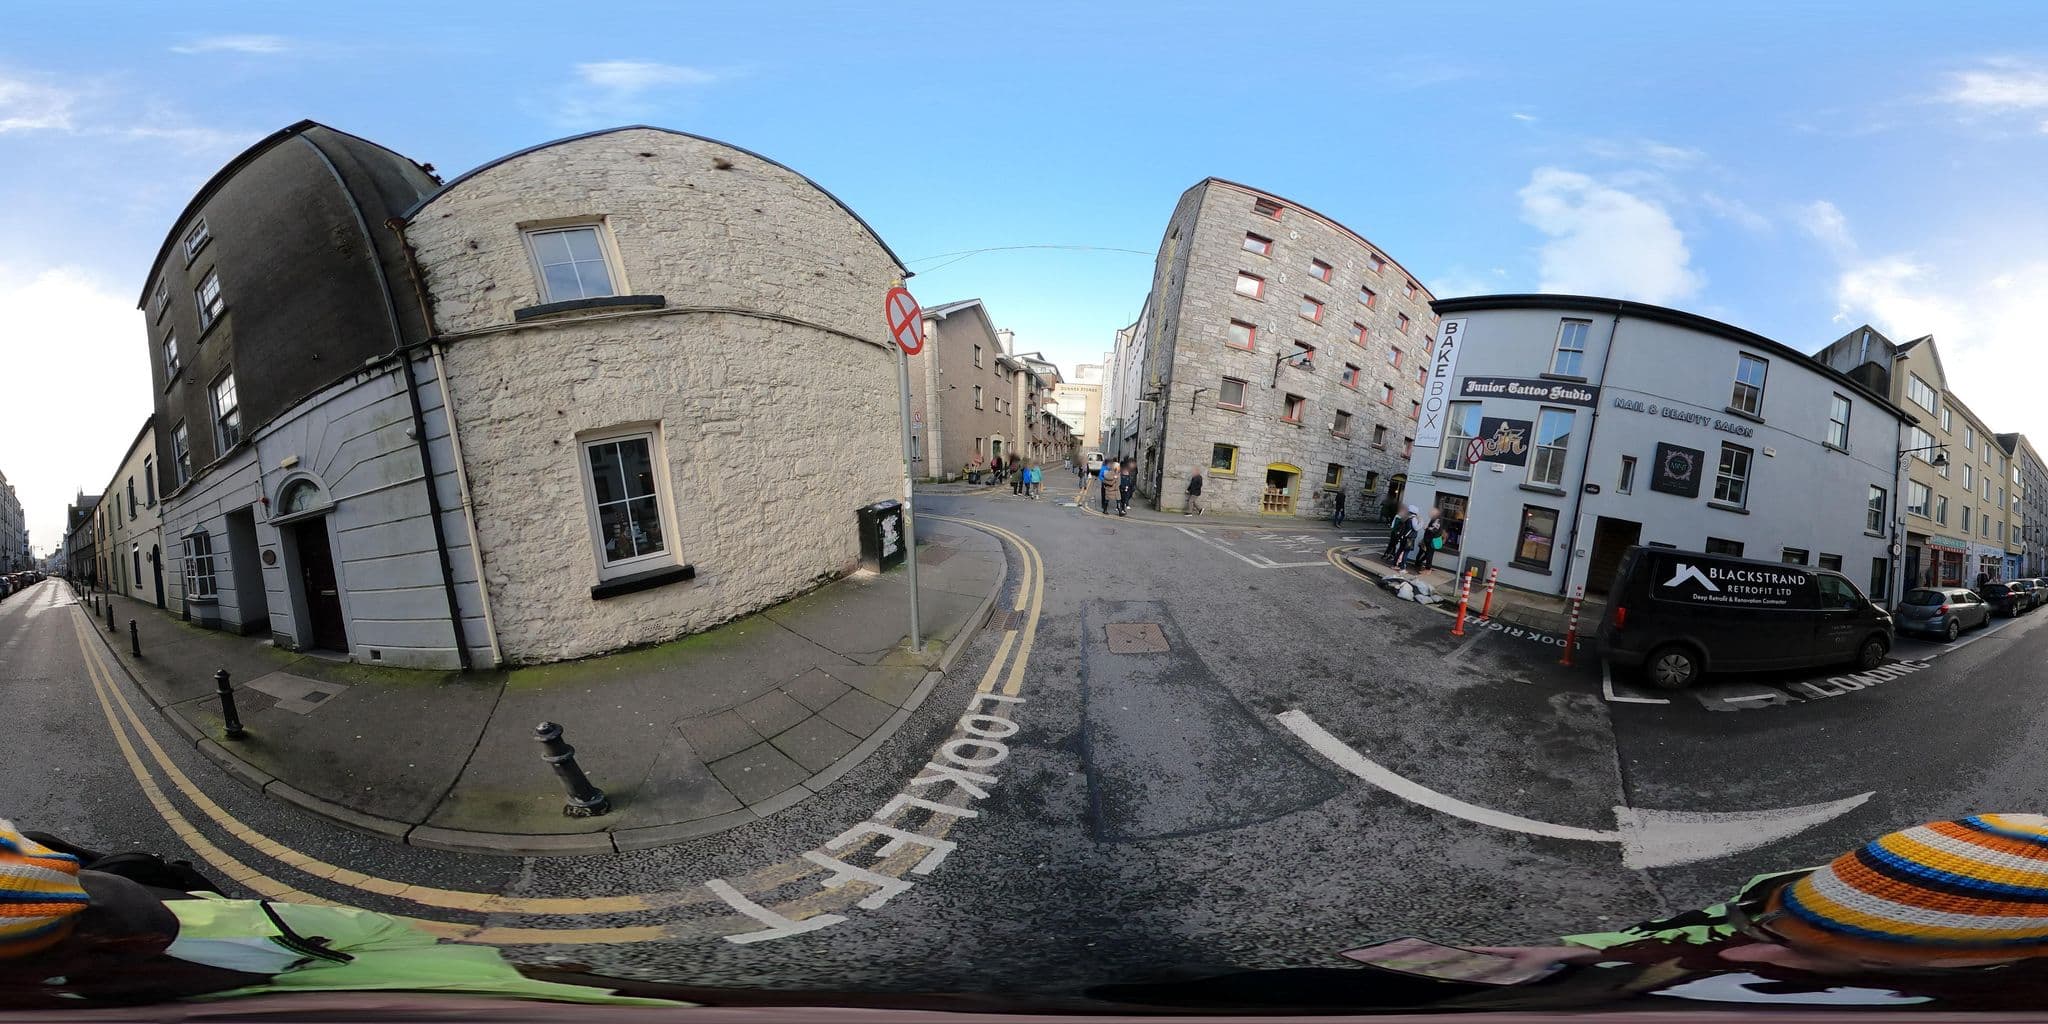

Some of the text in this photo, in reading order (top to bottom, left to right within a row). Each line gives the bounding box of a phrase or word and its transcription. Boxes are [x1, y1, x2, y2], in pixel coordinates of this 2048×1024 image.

[1424, 322, 1458, 430] BAKE BOX
[1466, 381, 1592, 401] Junior Tattoo Studio
[1615, 397, 1754, 438] NAIL & BEAUTY SALON
[1709, 567, 1806, 585] BLACKSTRAND
[1727, 585, 1792, 596] RETROFIT LTD
[1692, 594, 1708, 602] Deep
[1801, 660, 1931, 698] LOADING
[705, 693, 1027, 944] LOOK LEFT
